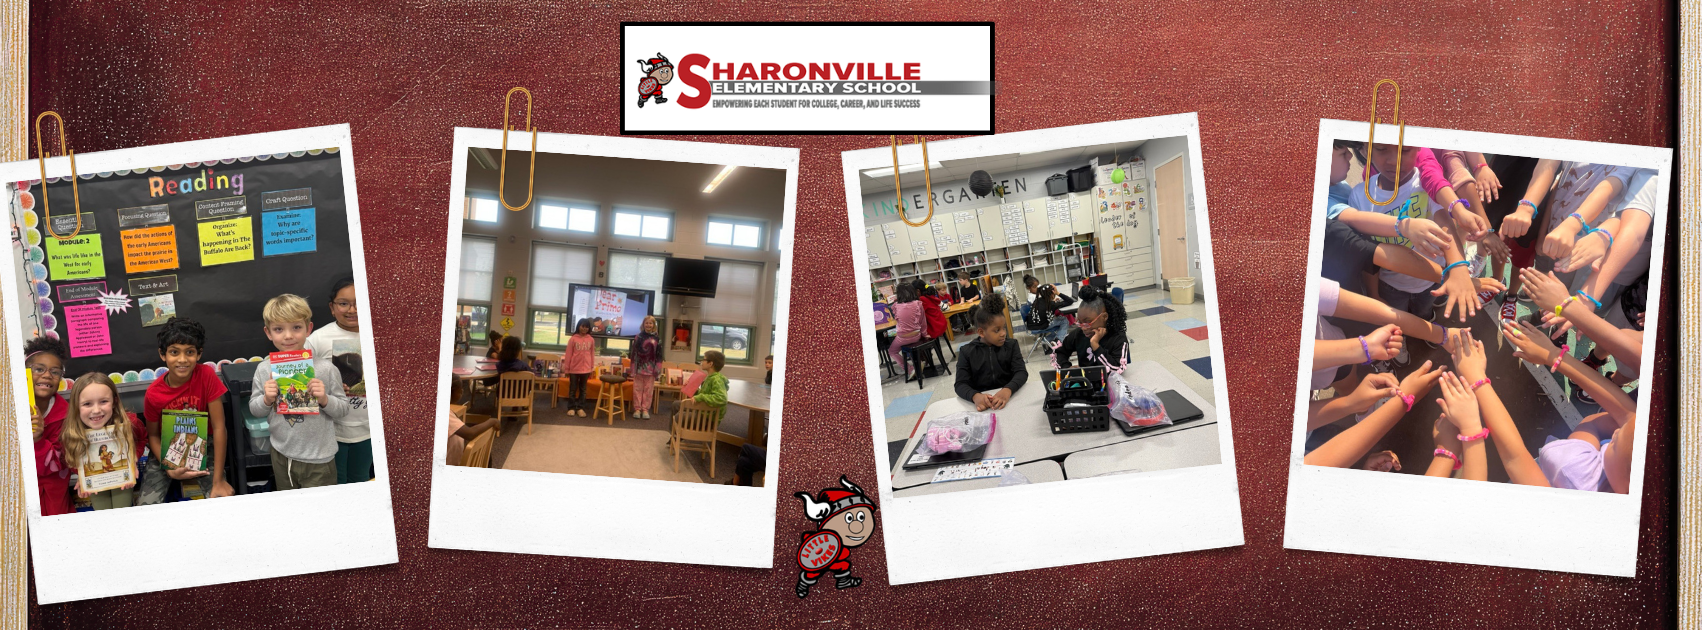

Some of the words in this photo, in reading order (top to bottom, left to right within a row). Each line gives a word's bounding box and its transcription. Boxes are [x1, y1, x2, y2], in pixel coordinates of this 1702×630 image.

[148, 168, 244, 198] Reading
[282, 195, 308, 203] Question
[271, 228, 308, 236] topic-specific
[202, 238, 232, 247] happening
[284, 234, 314, 243] important?
[176, 416, 196, 425] PLAINS
[173, 424, 198, 434] INDIANS
